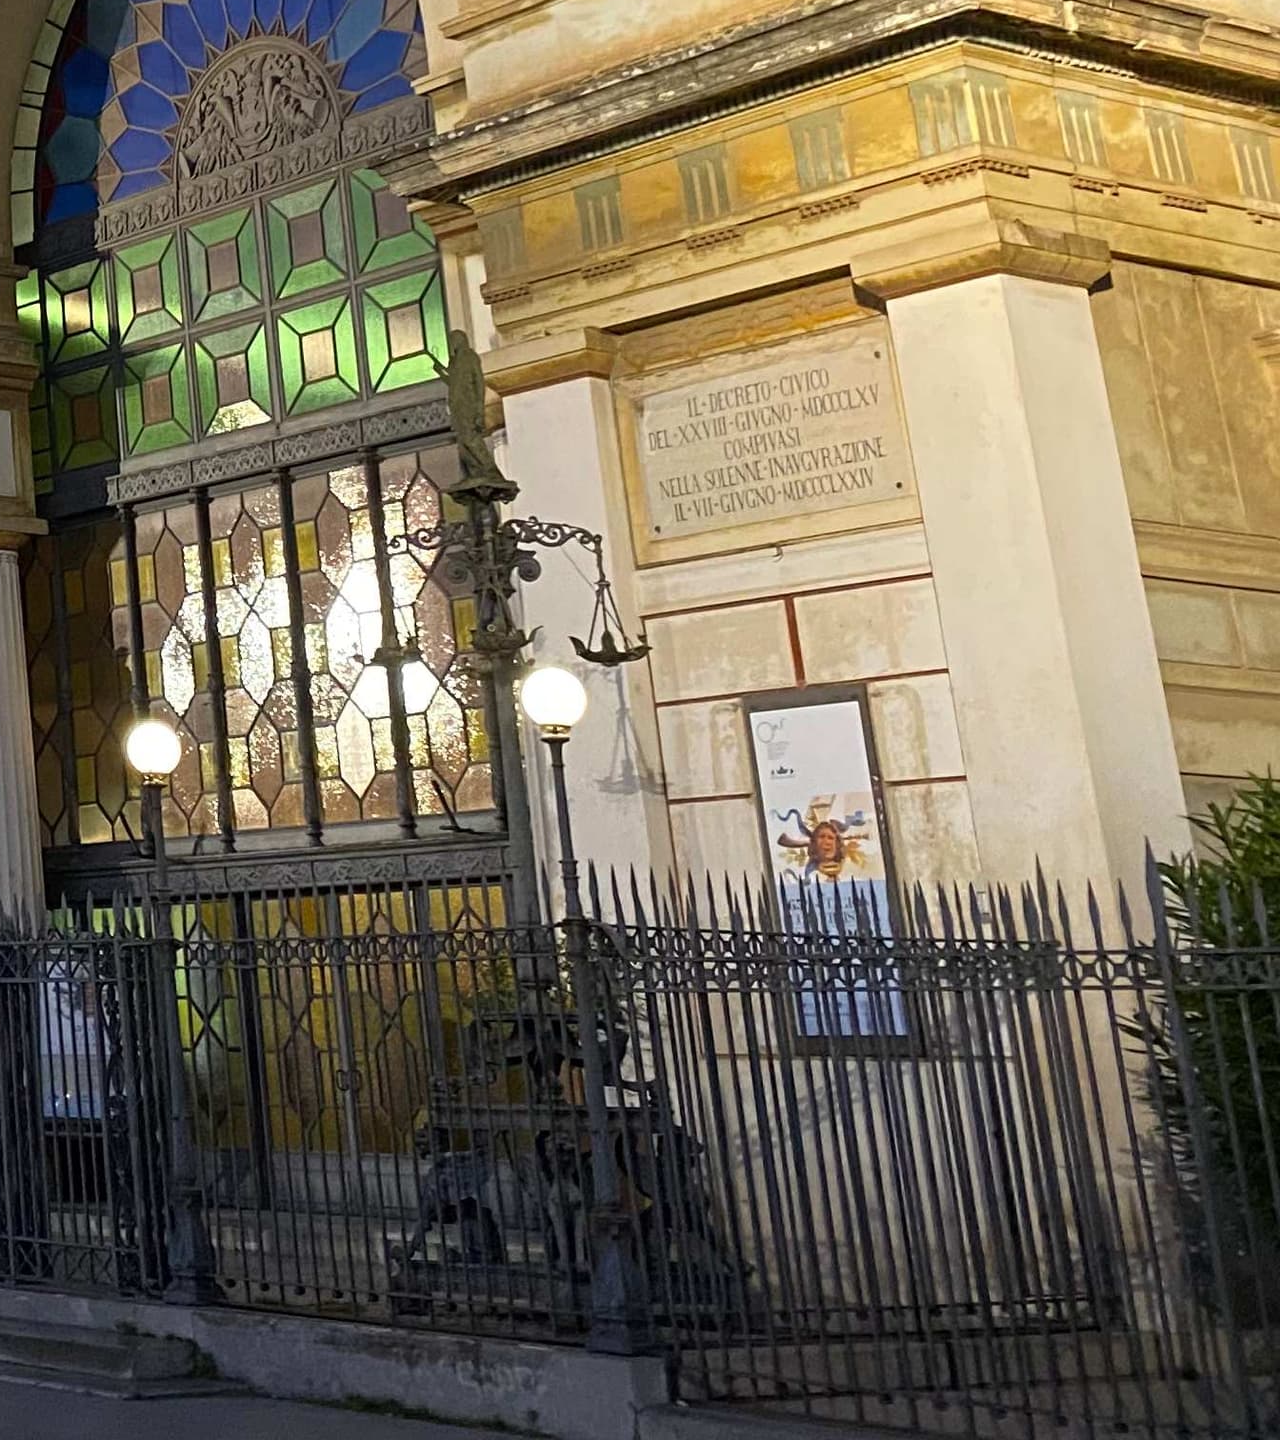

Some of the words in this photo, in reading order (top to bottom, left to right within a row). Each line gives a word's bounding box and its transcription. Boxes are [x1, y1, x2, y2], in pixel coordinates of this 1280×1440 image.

[686, 396, 702, 418] IL
[708, 381, 772, 412] DECRETO
[777, 368, 830, 397] CIVICO
[648, 428, 672, 452] DEL
[734, 404, 793, 432] GIVGNO
[723, 428, 801, 460] COMPIVASI
[658, 474, 701, 499] NELLA
[703, 462, 764, 490] SOLENNE
[719, 486, 776, 513] GIVGNO
